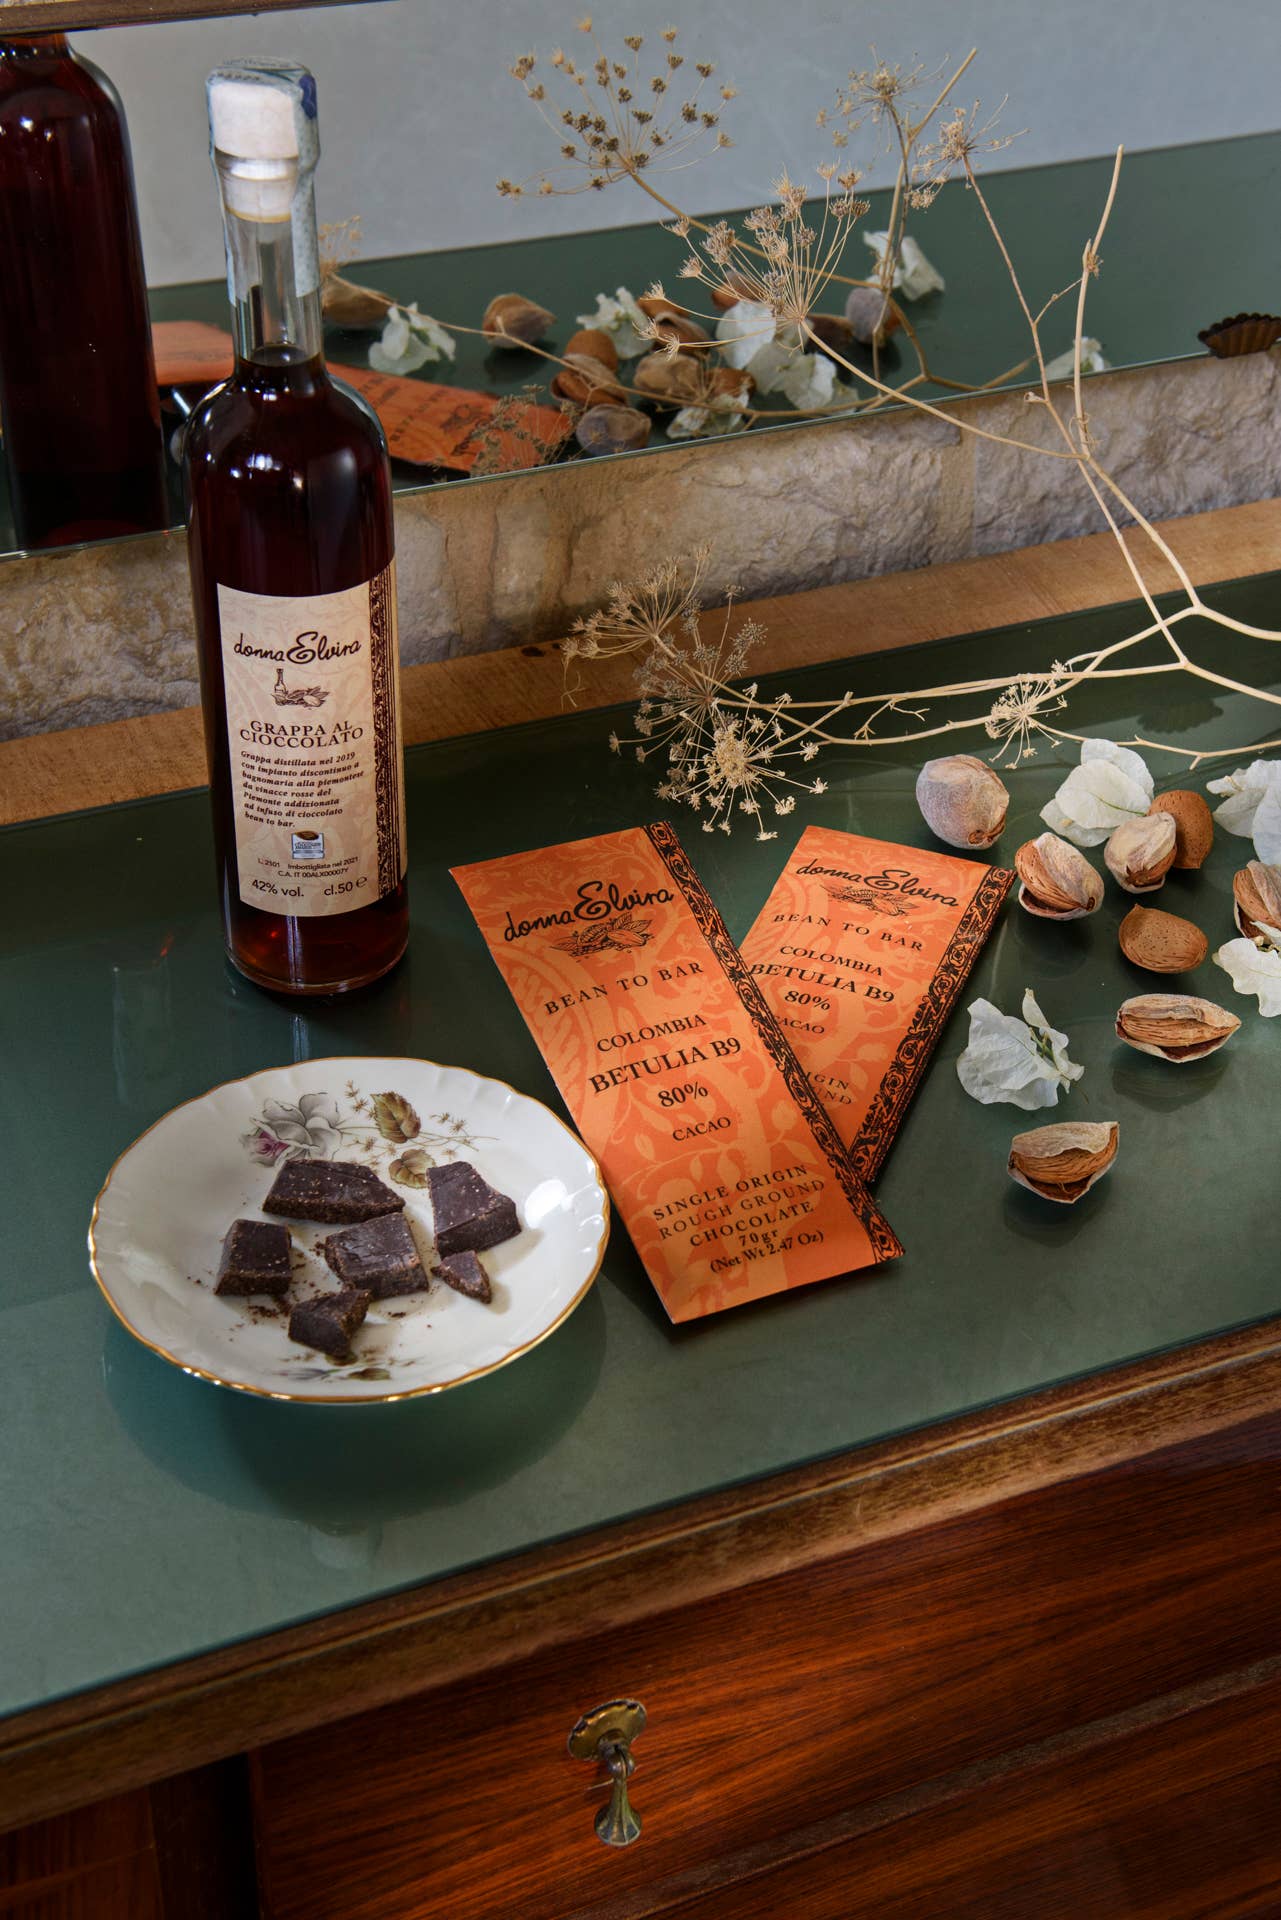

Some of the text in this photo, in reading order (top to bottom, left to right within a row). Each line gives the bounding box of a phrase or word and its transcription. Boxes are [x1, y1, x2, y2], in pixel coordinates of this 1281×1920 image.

[240, 729, 363, 748] CIOCCOLATO
[250, 720, 353, 736] GRAPPA AL
[241, 750, 271, 764] Grappa
[274, 758, 316, 766] distillata
[335, 751, 356, 762] 2019
[241, 761, 255, 770] con
[258, 766, 298, 777] impianto
[300, 764, 352, 776] discontinuo
[242, 770, 364, 788] bagnomaria alla piemontese
[243, 781, 253, 790] da
[255, 785, 288, 797] vinacce
[317, 787, 332, 796] del
[243, 790, 340, 808] Piemonte addizionata
[244, 802, 343, 818] ad infuso di cioccolato
[245, 811, 296, 828] bean to bar.
[251, 879, 278, 895] 42%
[280, 886, 305, 897] vol.
[323, 880, 354, 897] cl.50
[773, 914, 923, 951] BEAN TO BAR
[779, 945, 883, 977] COLOMBIA
[544, 962, 704, 1015] BEAN TO BAR
[747, 963, 895, 1003] BETULIA B9
[784, 990, 831, 1011] 80%
[596, 1014, 707, 1052] COLOMBIA
[588, 1037, 741, 1094] BETULIA B9
[657, 1081, 709, 1108] 80%
[672, 1116, 731, 1141] CACAO
[653, 1164, 808, 1222] SINGLE ORIGIN
[658, 1179, 825, 1241] ROUGH GROUND
[690, 1201, 814, 1248] CHOCOLATE
[710, 1230, 825, 1274] (Net Wt 2.47 Oz)
